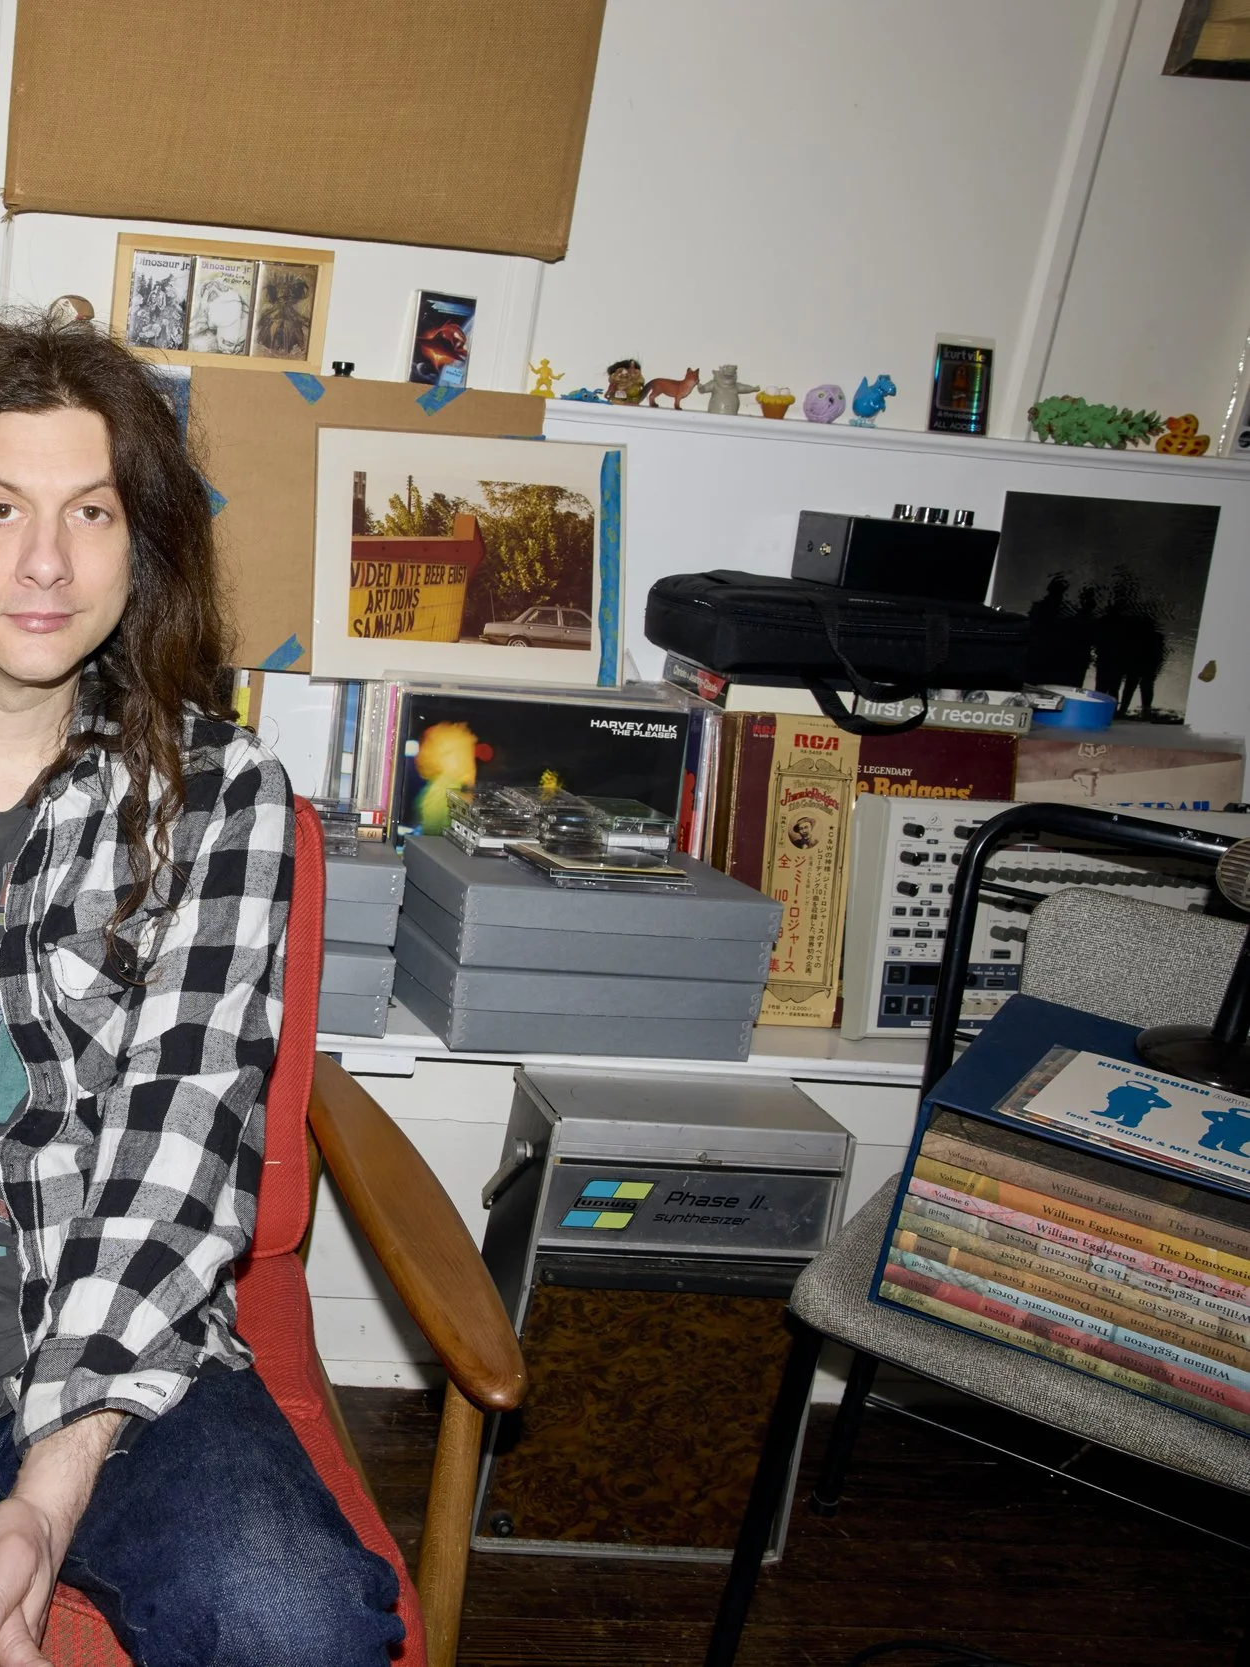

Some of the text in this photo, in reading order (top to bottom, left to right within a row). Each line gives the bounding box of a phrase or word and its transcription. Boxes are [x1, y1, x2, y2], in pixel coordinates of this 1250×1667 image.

[201, 261, 240, 272] Dinosaur
[943, 348, 986, 362] kurt vile
[949, 423, 982, 432] ACCESS
[350, 562, 445, 588] VIDEO NITE BEER
[364, 588, 420, 615] ARTOONS
[353, 610, 415, 638] SAMHAIN
[590, 719, 678, 733] HARVEY MILK
[863, 700, 1015, 727] first sx records
[611, 728, 678, 739] THE PLEASER
[794, 733, 839, 751] RCA
[863, 765, 913, 777] LEGENDARY
[782, 855, 807, 973] ジミー・ロジャース
[1097, 1060, 1210, 1096] KING GEEDORAH
[1065, 1111, 1091, 1123] feat.
[1095, 1121, 1113, 1129] MF
[1117, 1127, 1153, 1142] DOOM
[1169, 1145, 1190, 1156] MR
[573, 1198, 637, 1211] Ludwig
[664, 1191, 739, 1209] Phase
[948, 1150, 976, 1164] Volume
[1051, 1182, 1094, 1202] William
[1098, 1196, 1153, 1221] Eggleston
[1167, 1218, 1190, 1234] The
[653, 1212, 749, 1227] synthesizer
[940, 1173, 967, 1187] Volume
[1043, 1205, 1085, 1225] William
[1089, 1220, 1143, 1245] Eggleston
[1159, 1242, 1180, 1257] The
[934, 1190, 962, 1204] Volume
[1036, 1222, 1079, 1243] William
[1082, 1237, 1137, 1265] Eggleston
[1151, 1261, 1173, 1276] The
[1178, 1269, 1247, 1299] Democratic
[928, 1208, 1250, 1323] William Eggleston The Democratic Forest Steidl
[994, 1270, 1025, 1287] Forest
[923, 1226, 1247, 1344] William Eggleston The Democratic Forest Steidl
[1030, 1282, 1091, 1311] Democratic
[911, 1260, 1231, 1381] William Eggleston The Democratic Forest Steidl
[1094, 1304, 1115, 1320] The
[1130, 1318, 1186, 1345] Eggleston
[1190, 1339, 1237, 1363] William
